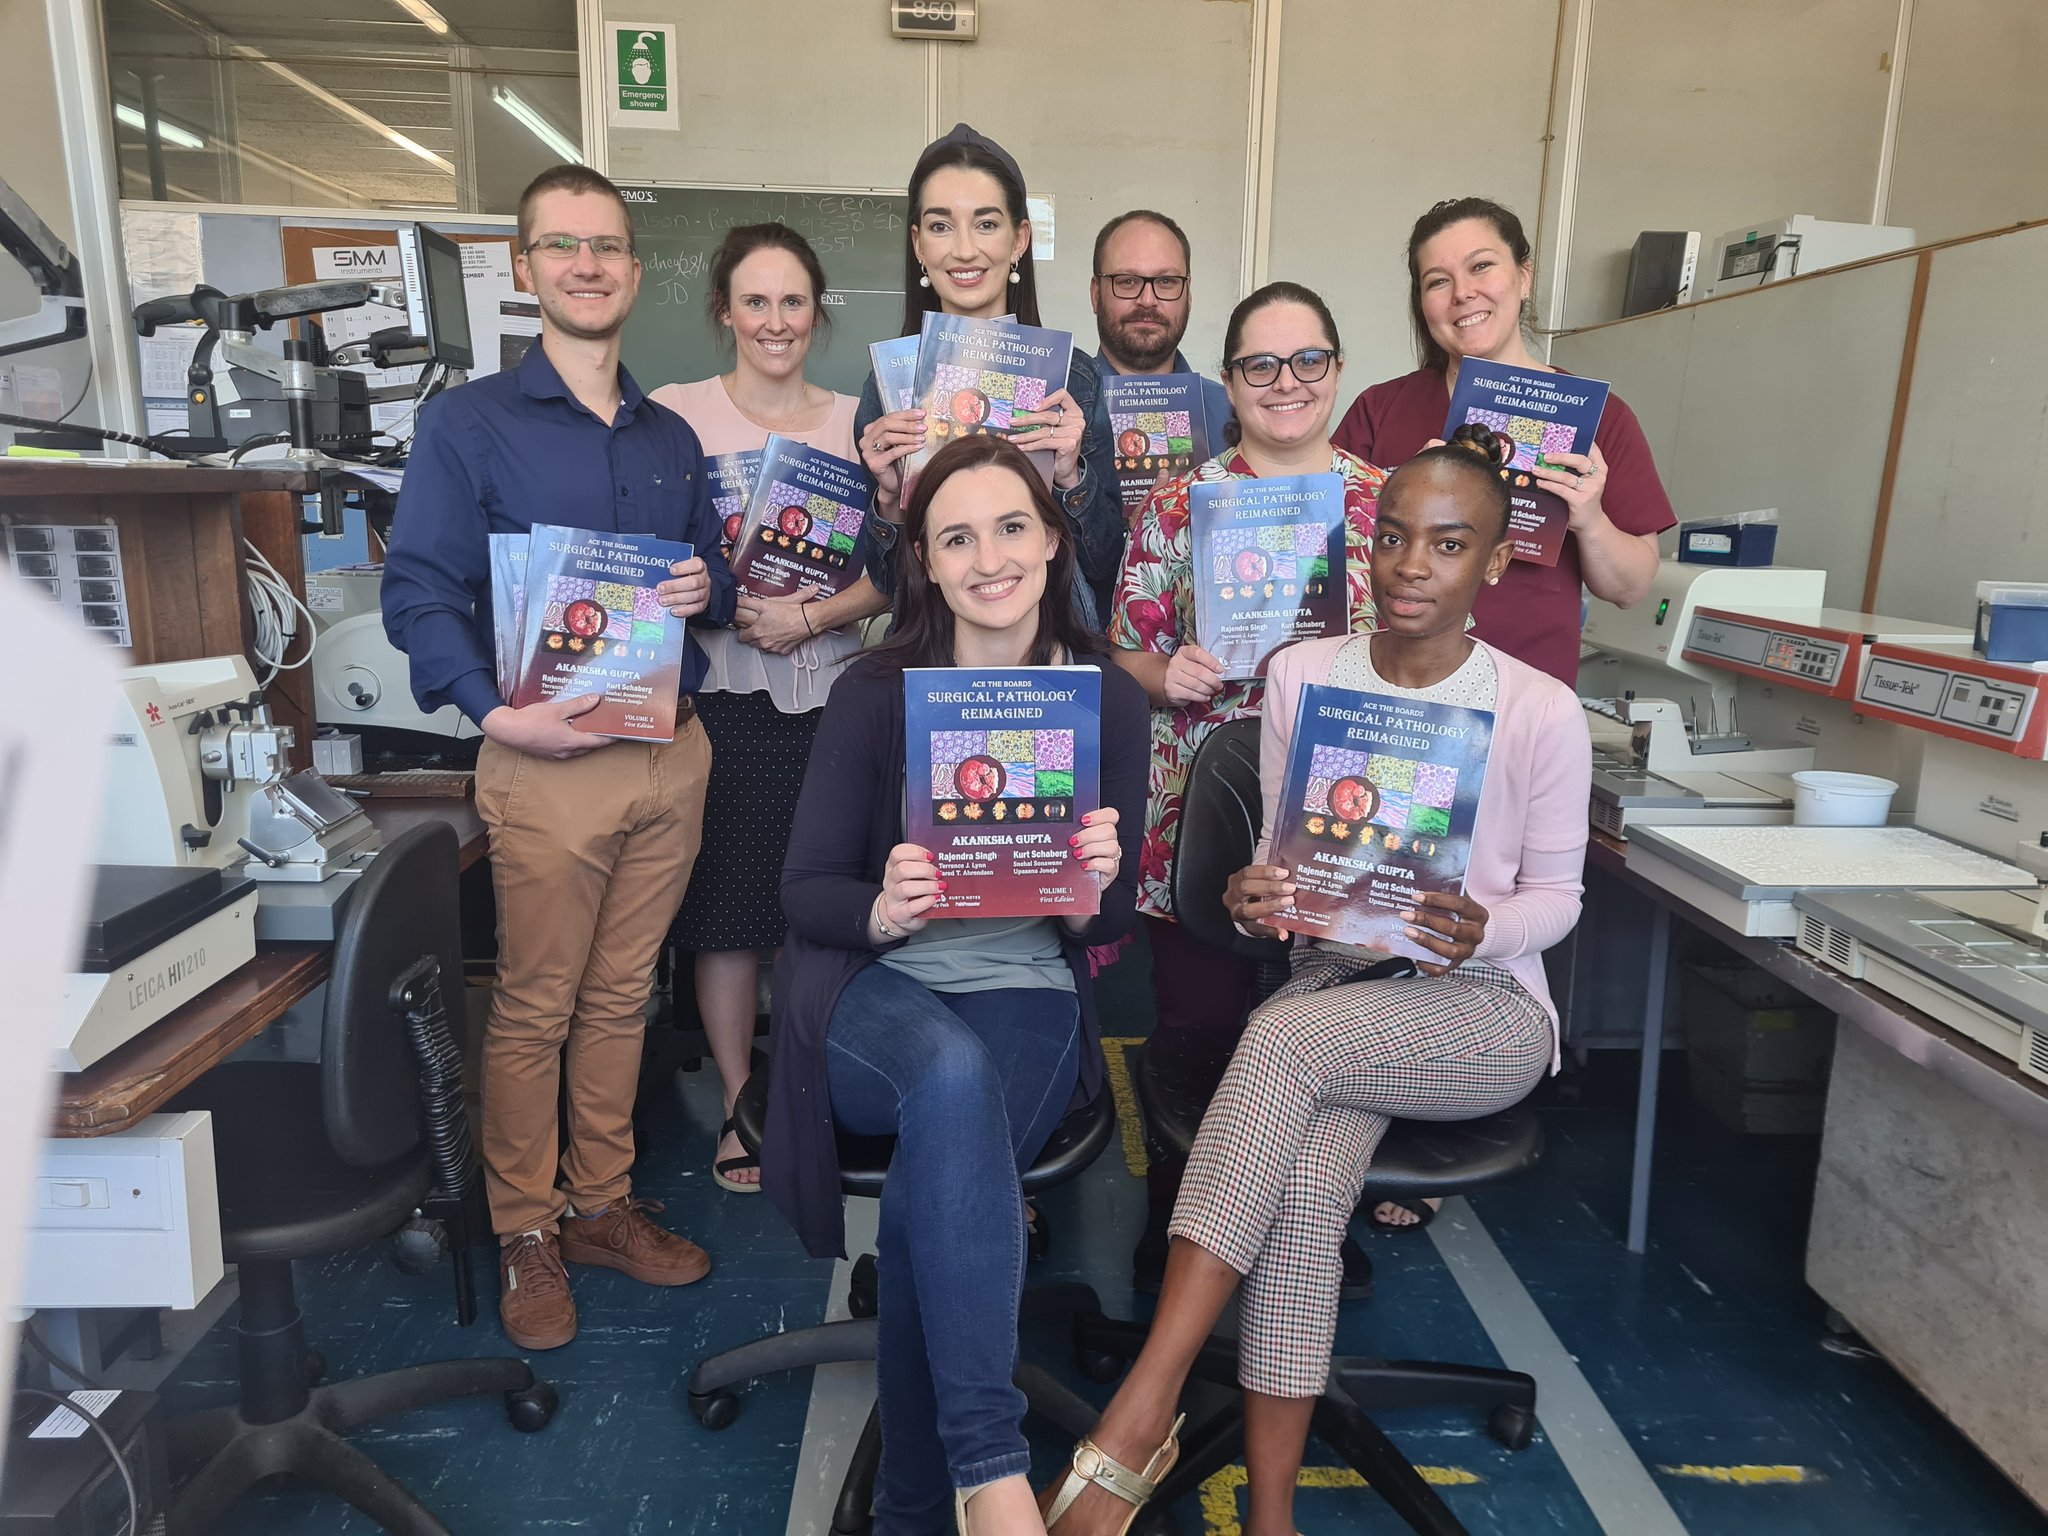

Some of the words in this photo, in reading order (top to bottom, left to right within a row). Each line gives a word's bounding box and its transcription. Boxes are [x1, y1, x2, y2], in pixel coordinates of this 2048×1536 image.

[622, 90, 665, 100] Emergency
[629, 100, 658, 108] shower
[333, 249, 387, 266] SMM
[340, 267, 383, 275] Instruments
[973, 328, 986, 336] ACE
[986, 329, 998, 337] THE
[998, 331, 1021, 341] BOARDS
[938, 331, 990, 348] SURGICAL
[992, 340, 1054, 358] PATHOLOGY
[962, 348, 1026, 367] REIMAGINED
[1520, 377, 1533, 385] THE
[1532, 379, 1556, 389] BOARDS
[1139, 385, 1188, 396] PATHOLOGY
[1472, 376, 1523, 395] SURGICAL
[1524, 387, 1589, 406] PATHOLOGY
[1119, 397, 1169, 407] REIMAGINED
[1494, 394, 1558, 414] REIMAGINED
[778, 453, 821, 476] SURGICAL
[820, 460, 830, 468] THE
[829, 463, 849, 475] BOARDS
[796, 472, 850, 498] REIMAGINED
[1267, 485, 1291, 493] BOARDS
[1208, 496, 1261, 509] SURGICAL
[1263, 489, 1327, 505] PATHOLOGY
[1235, 506, 1301, 520] REIMAGINED
[587, 538, 600, 546] ACE
[601, 540, 614, 548] THE
[614, 542, 639, 551] BOARDS
[549, 541, 605, 559] SURGICAL
[608, 550, 675, 569] PATHOLOGY
[576, 559, 645, 578] REIMAGINED
[751, 559, 775, 573] Rajendra
[774, 567, 791, 578] Singh
[763, 552, 804, 572] AKANKSHA
[804, 566, 829, 581] GUPTA
[799, 576, 811, 585] Kurt
[1231, 609, 1281, 621] AKANKSHA
[1282, 607, 1312, 617] GUPTA
[1220, 624, 1249, 634] Rajendra
[1249, 623, 1269, 632] Singh
[1295, 620, 1326, 629] Schaberg
[555, 663, 608, 676] AKANKSHA
[610, 669, 640, 680] GUPTA
[542, 674, 573, 685] Rajendra
[573, 678, 593, 688] Singh
[987, 680, 1003, 688] THE
[1003, 680, 1032, 688] BOARDS
[606, 682, 621, 690] Kurt
[621, 683, 653, 694] Schaberg
[927, 691, 994, 703] SURGICAL
[997, 689, 1077, 703] PATHOLOGY
[961, 707, 1043, 720] REIMAGINED
[1363, 701, 1378, 710] ACE
[1378, 704, 1394, 714] THE
[1394, 706, 1425, 718] BOARDS
[624, 714, 649, 722] VOLUME
[1318, 705, 1382, 726] SURGICAL
[1385, 716, 1469, 739] PATHOLOGY
[1346, 727, 1430, 751] REIMAGINED
[952, 835, 1014, 846] AKANKSHA
[1015, 833, 1053, 844] GUPTA
[938, 852, 974, 862] Rajendra
[974, 851, 998, 861] Singh
[1013, 850, 1030, 859] Kurt
[1032, 849, 1068, 860] Schaberg
[971, 862, 987, 870] Lynn
[1312, 851, 1375, 872] AKANKSHA
[1376, 864, 1416, 881] GUPTA
[1297, 864, 1333, 879] Rajendra
[1333, 871, 1356, 884] Singh
[1038, 887, 1067, 895] VOLUME
[1327, 880, 1343, 890] Lynn
[1371, 879, 1390, 891] Kurt
[1054, 895, 1075, 903] Edition
[128, 971, 166, 1011] LEICA
[168, 947, 206, 987] HI1210
